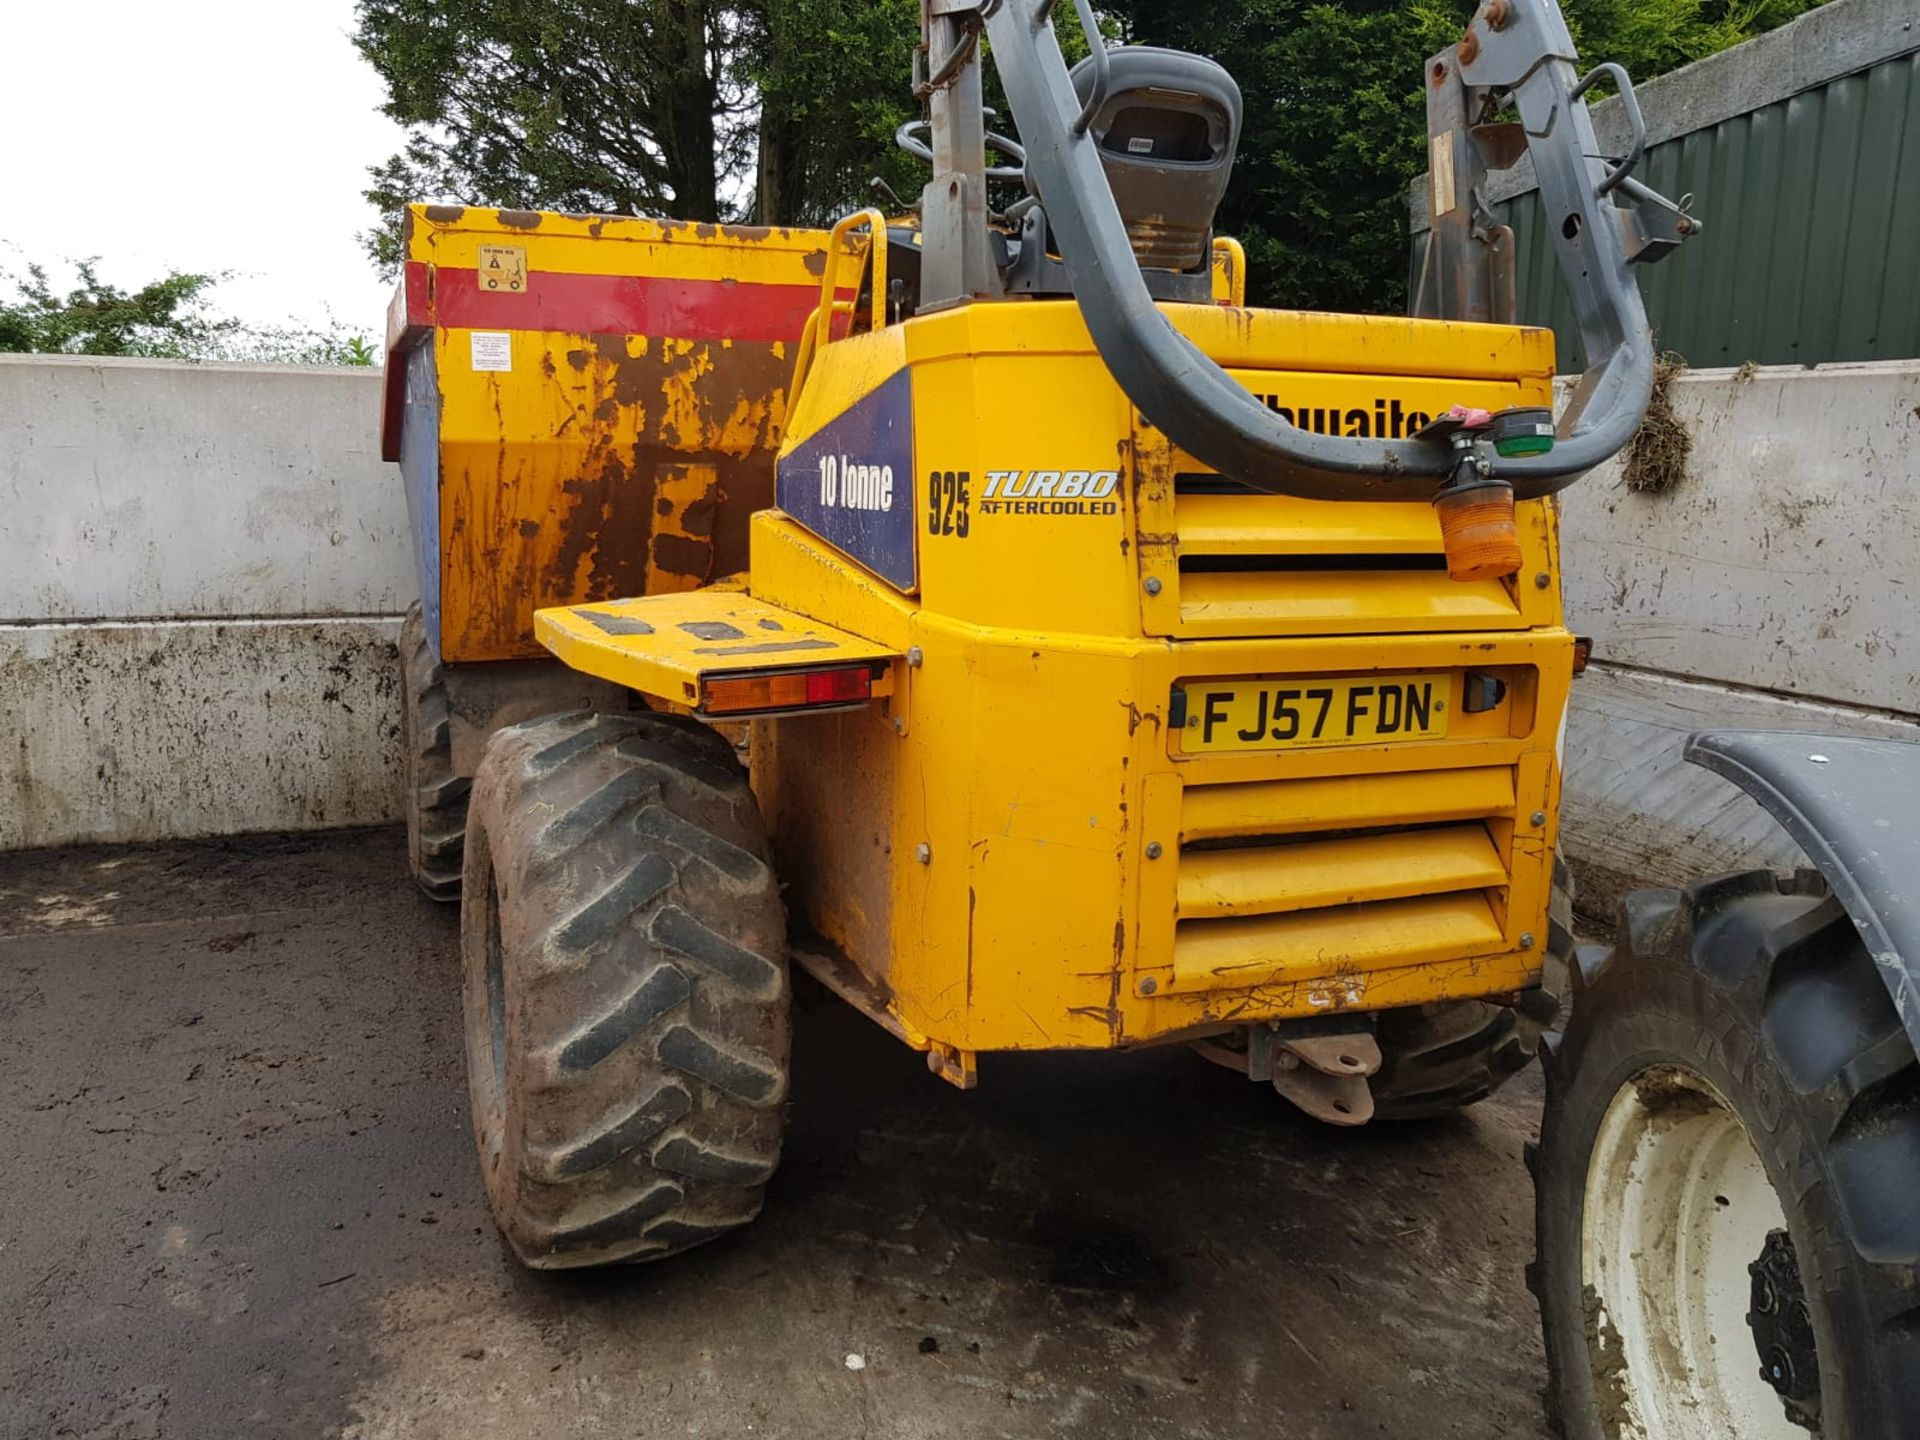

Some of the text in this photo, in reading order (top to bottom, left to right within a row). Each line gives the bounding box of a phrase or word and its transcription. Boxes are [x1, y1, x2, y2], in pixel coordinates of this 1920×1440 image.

[819, 454, 894, 512] 10 tonne
[928, 471, 971, 538] 925
[979, 501, 1117, 515] AFTERCOOLED
[981, 470, 1120, 499] TURBO
[1203, 683, 1432, 744] FJ57 FDN
